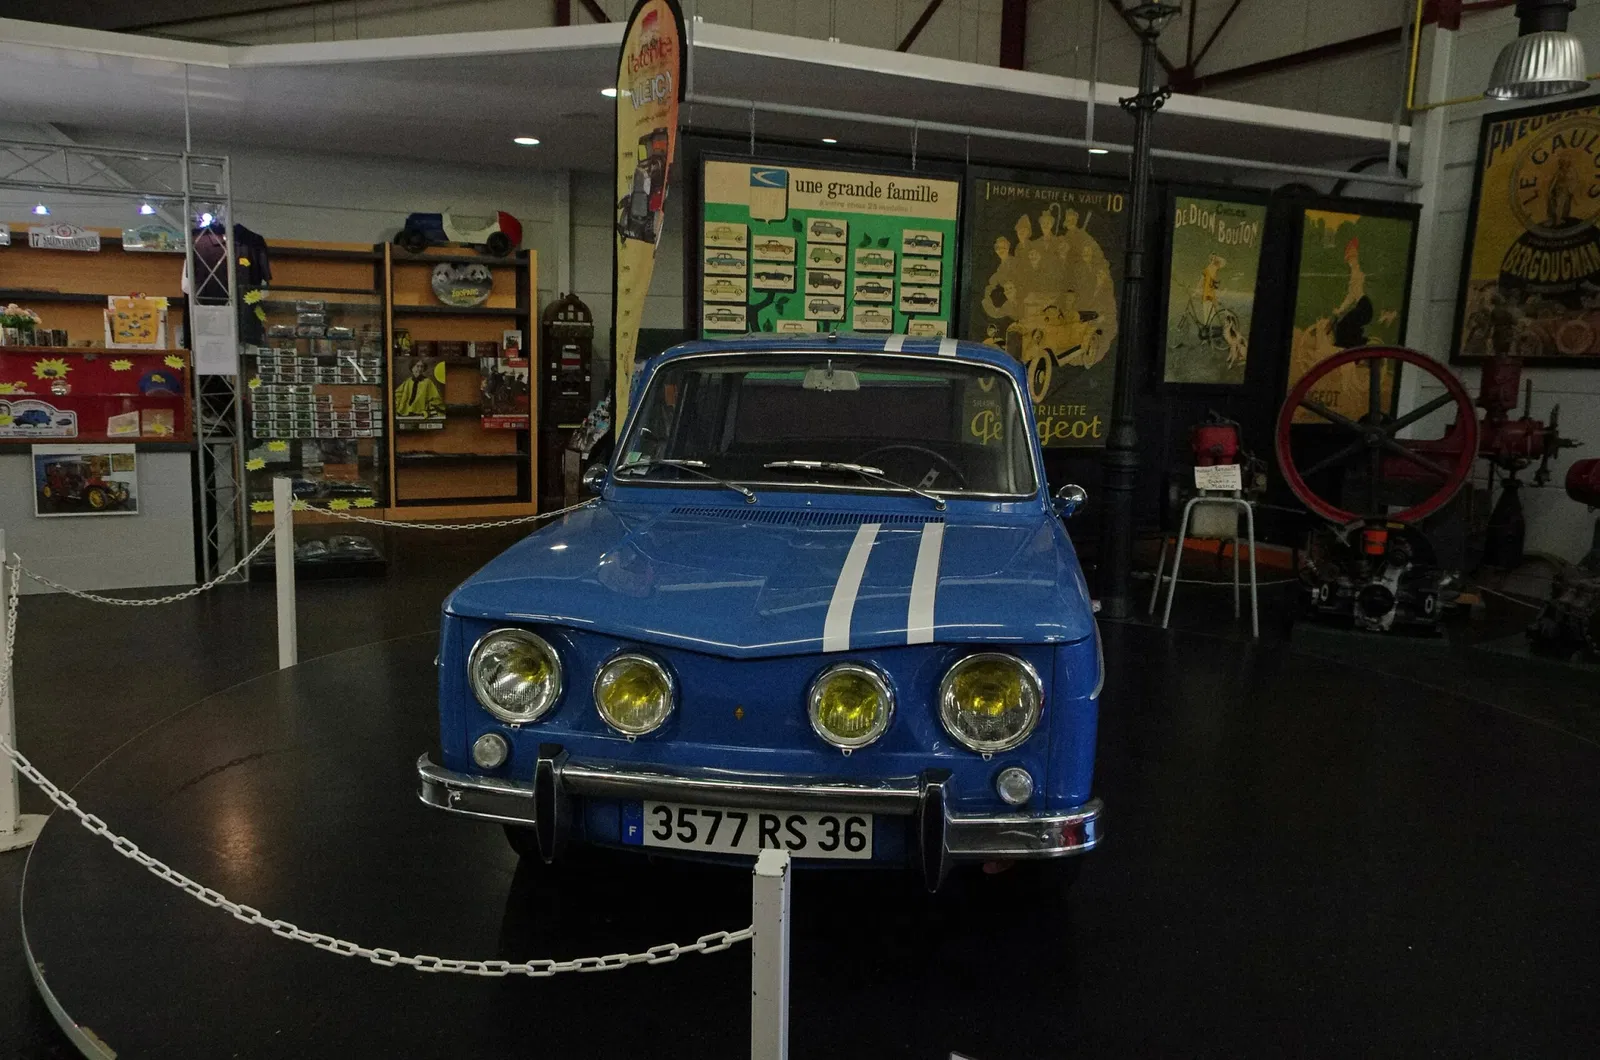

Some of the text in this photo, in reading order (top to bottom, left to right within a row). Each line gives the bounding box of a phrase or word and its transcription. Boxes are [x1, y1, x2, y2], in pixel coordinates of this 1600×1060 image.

[796, 179, 939, 203] une grande famille
[992, 185, 1031, 198] HOMME
[1034, 189, 1060, 200] ACTIF
[1062, 191, 1075, 203] EN
[1078, 193, 1103, 205] VAUT
[1106, 193, 1124, 213] 10
[1519, 175, 1540, 207] LE
[1189, 203, 1216, 234] DION
[628, 826, 637, 837] F
[651, 805, 867, 853] 3577 RS 36
